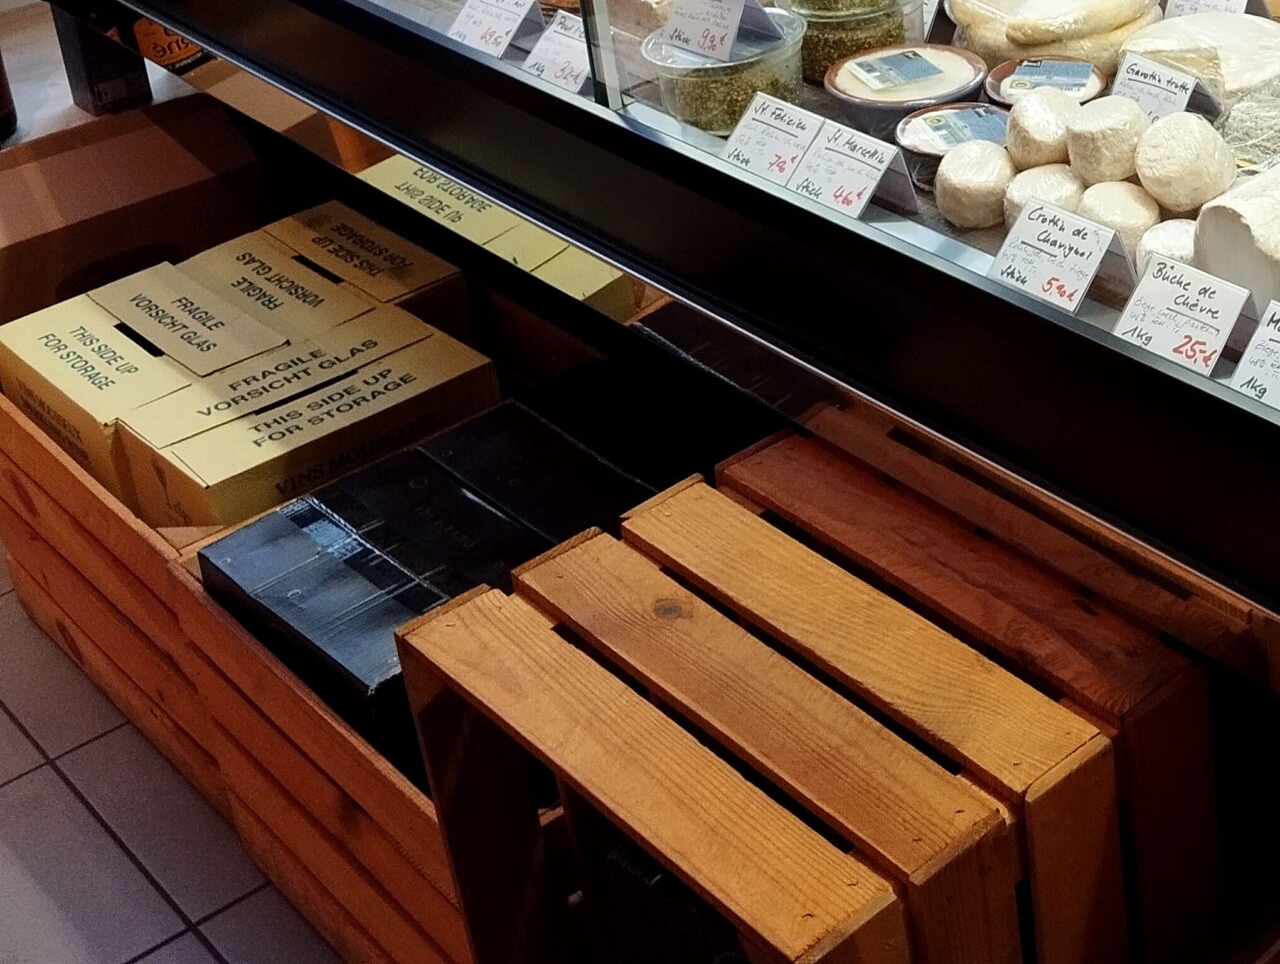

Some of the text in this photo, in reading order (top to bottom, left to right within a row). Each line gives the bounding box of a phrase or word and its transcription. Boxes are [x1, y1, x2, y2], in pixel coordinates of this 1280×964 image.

[311, 236, 332, 248] UP
[330, 222, 415, 268] FOR STORAGE
[1072, 226, 1088, 240] de
[230, 276, 284, 311] FRAGILE
[236, 252, 325, 308] VORSICHT GLAS
[1198, 286, 1216, 299] de
[129, 293, 217, 353] VORSICHT GLAS
[171, 296, 225, 332] FRAGILE
[38, 333, 116, 390] FOR STORAGE
[69, 325, 139, 375] THIS SIDE UP
[228, 348, 328, 392] FRAGILE
[197, 338, 379, 417] VORSICHT GLAS
[248, 368, 393, 434] THIS SIDE UP
[252, 423, 304, 448] FOR
[308, 372, 418, 427] STORAGE
